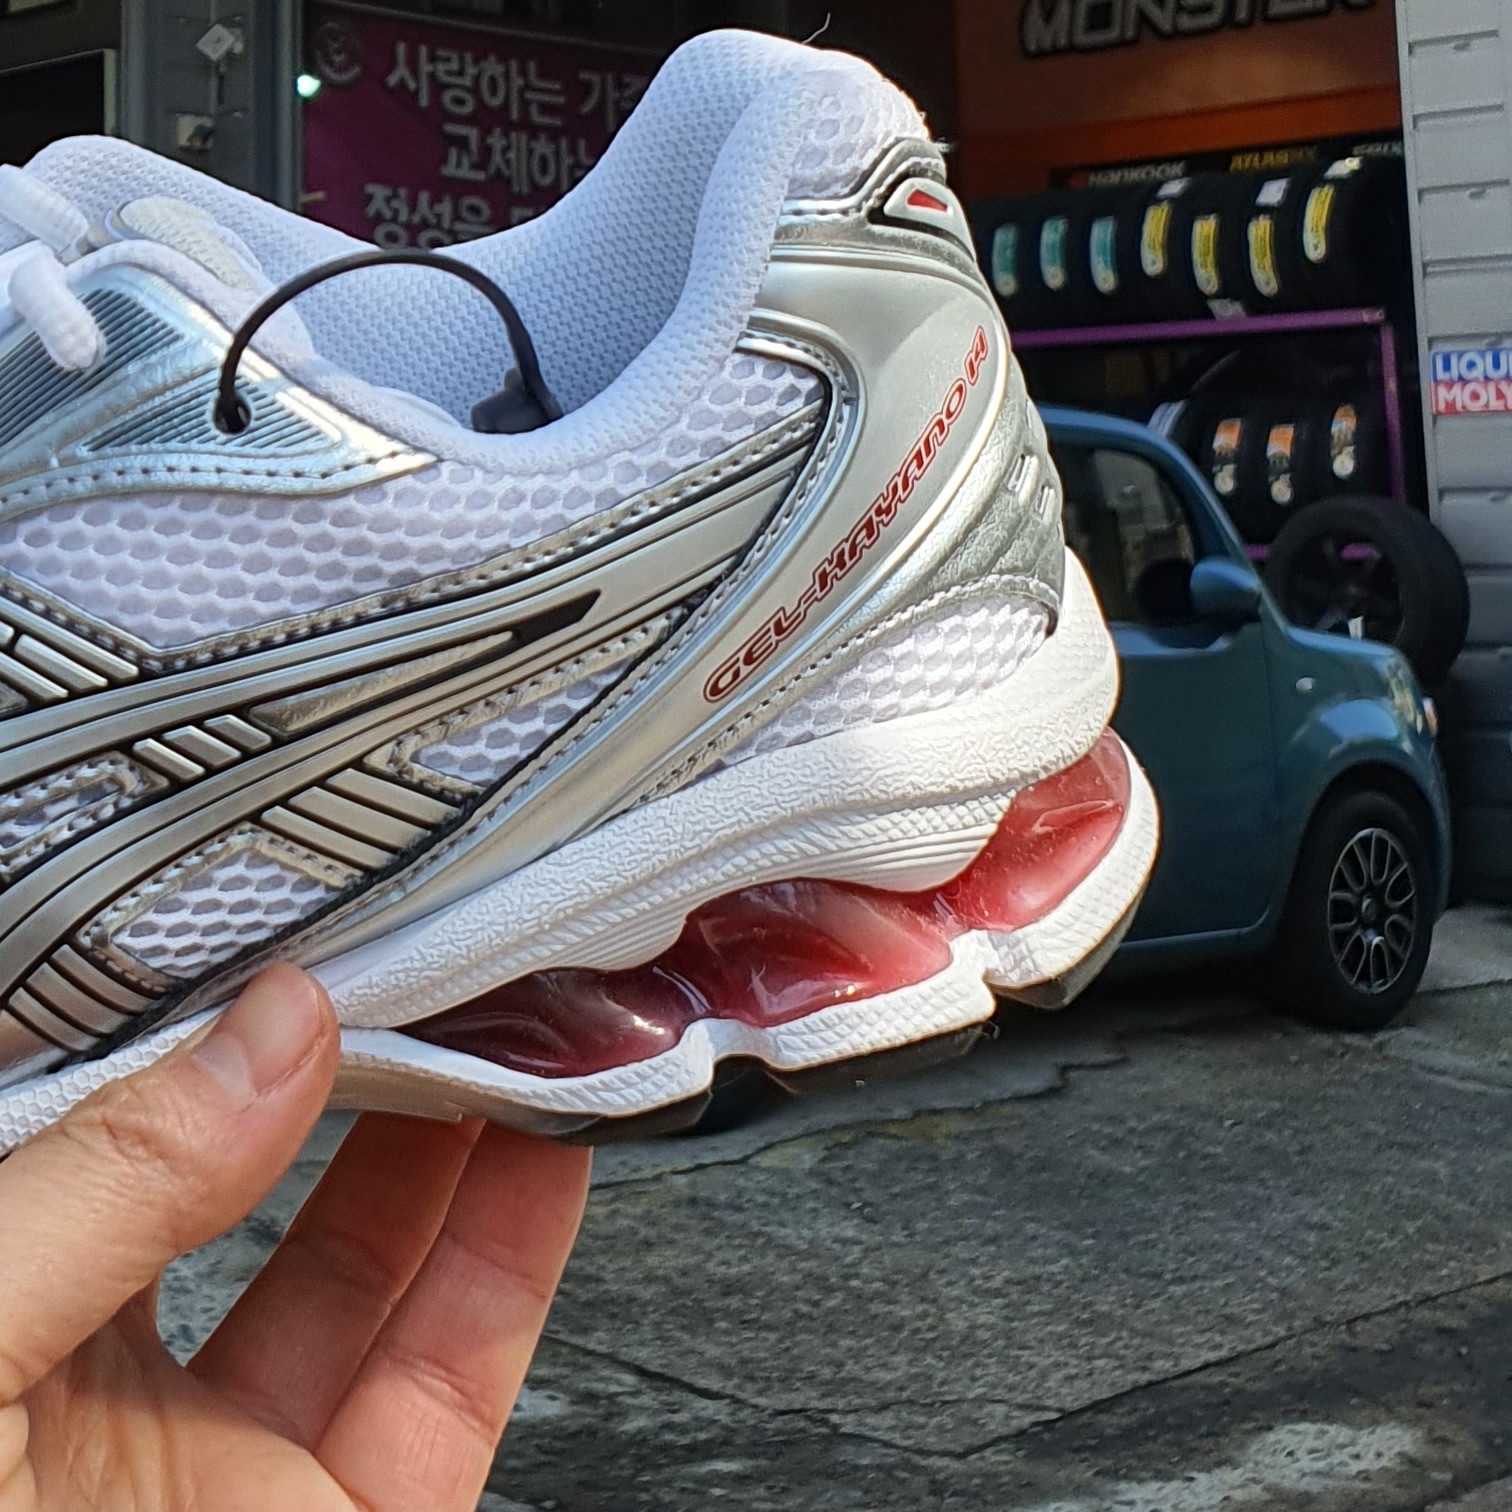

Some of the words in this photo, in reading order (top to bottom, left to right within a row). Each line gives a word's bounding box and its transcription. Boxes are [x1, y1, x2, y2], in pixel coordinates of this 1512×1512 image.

[387, 40, 566, 127] 사랑하는
[703, 377, 968, 703] GEL-KAYANO
[964, 324, 990, 387] 14
